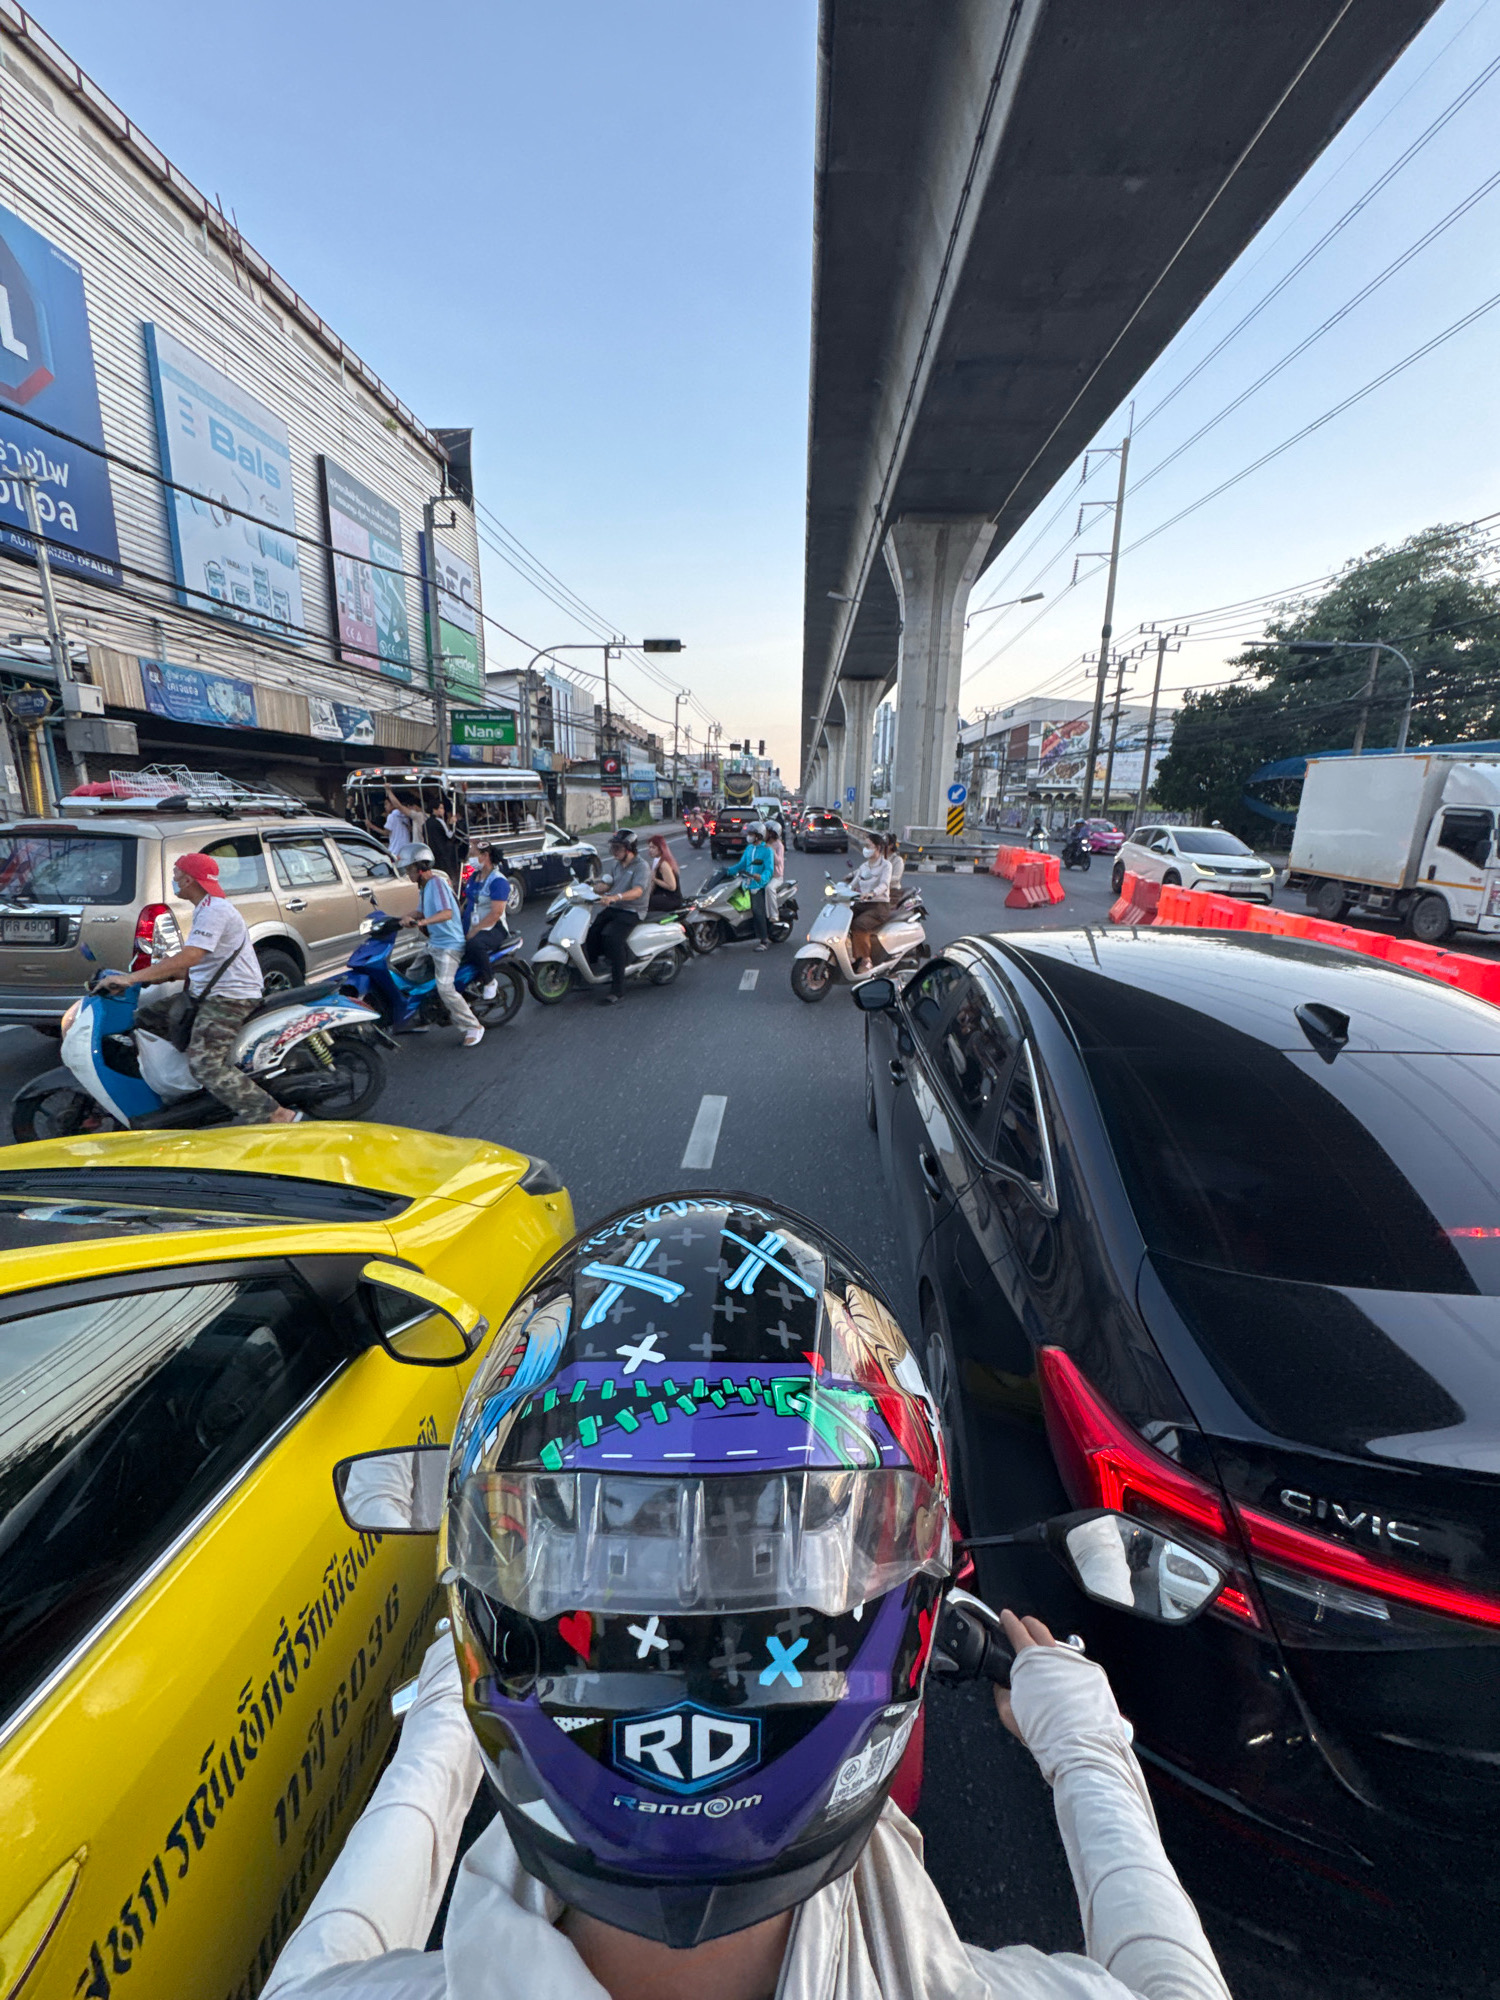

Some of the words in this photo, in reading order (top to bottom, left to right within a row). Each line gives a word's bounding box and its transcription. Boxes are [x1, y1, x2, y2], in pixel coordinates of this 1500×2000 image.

[208, 416, 281, 490] Bals
[10, 533, 75, 562] AUTRIZED
[77, 556, 114, 577] DEALER
[464, 725, 504, 739] Nano
[24, 921, 50, 933] 4900
[1280, 1488, 1421, 1546] CIVIC
[73, 1532, 387, 1999] สหกรณ์แท็กซี่รักเมือง
[624, 1714, 751, 1781] RD
[612, 1793, 763, 1819] Random
